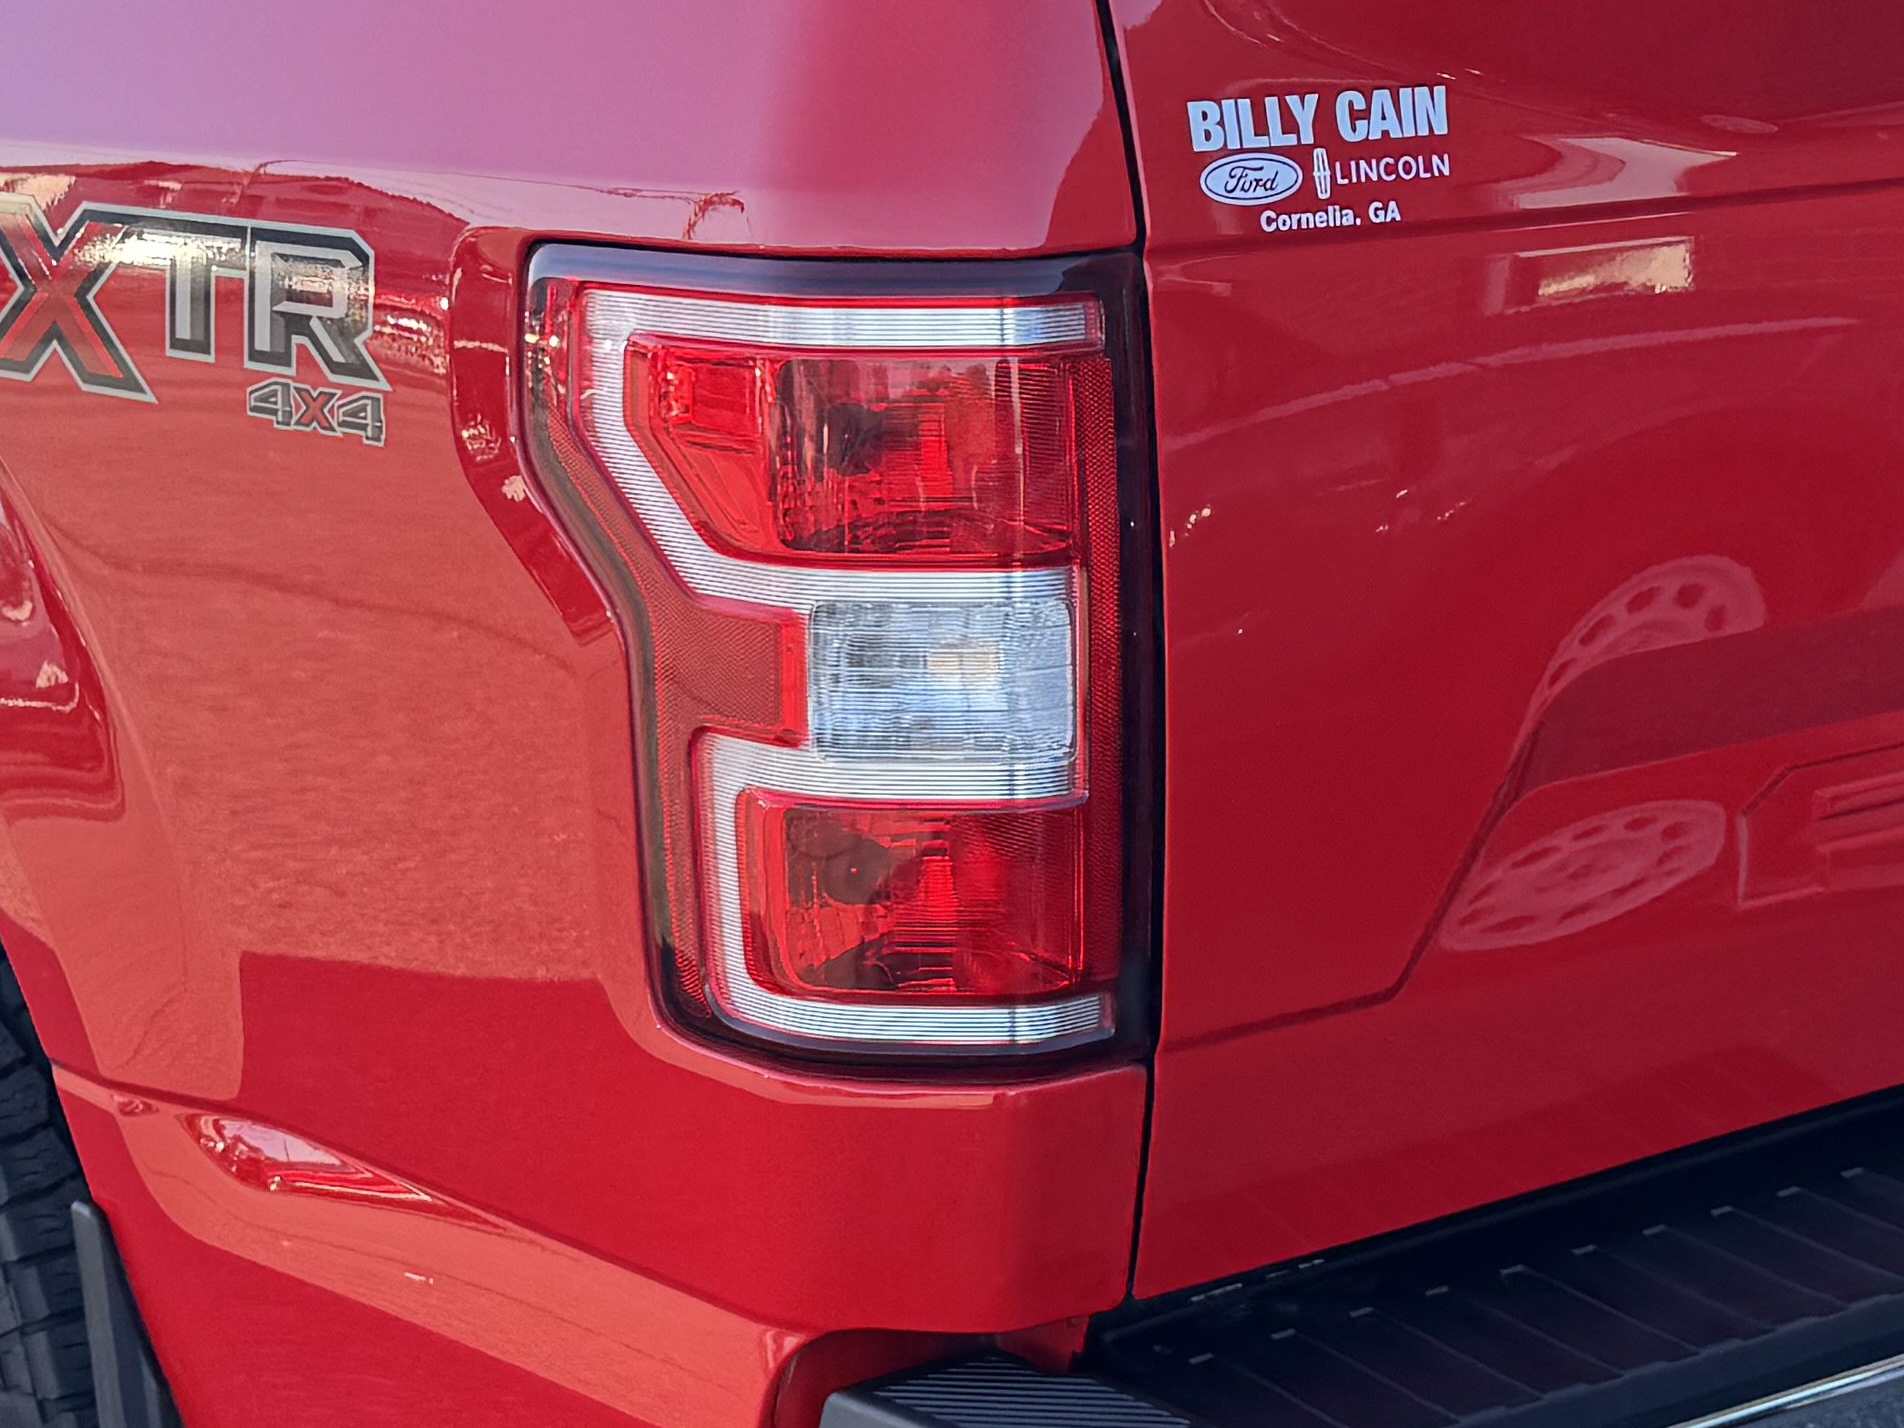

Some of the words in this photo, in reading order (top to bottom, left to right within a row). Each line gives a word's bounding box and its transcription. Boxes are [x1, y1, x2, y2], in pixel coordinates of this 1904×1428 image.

[1187, 93, 1319, 152] BILLY
[1335, 85, 1449, 143] CAIN
[1223, 165, 1279, 195] Ford
[1336, 153, 1451, 185] LINCOLN
[1369, 200, 1402, 224] GA
